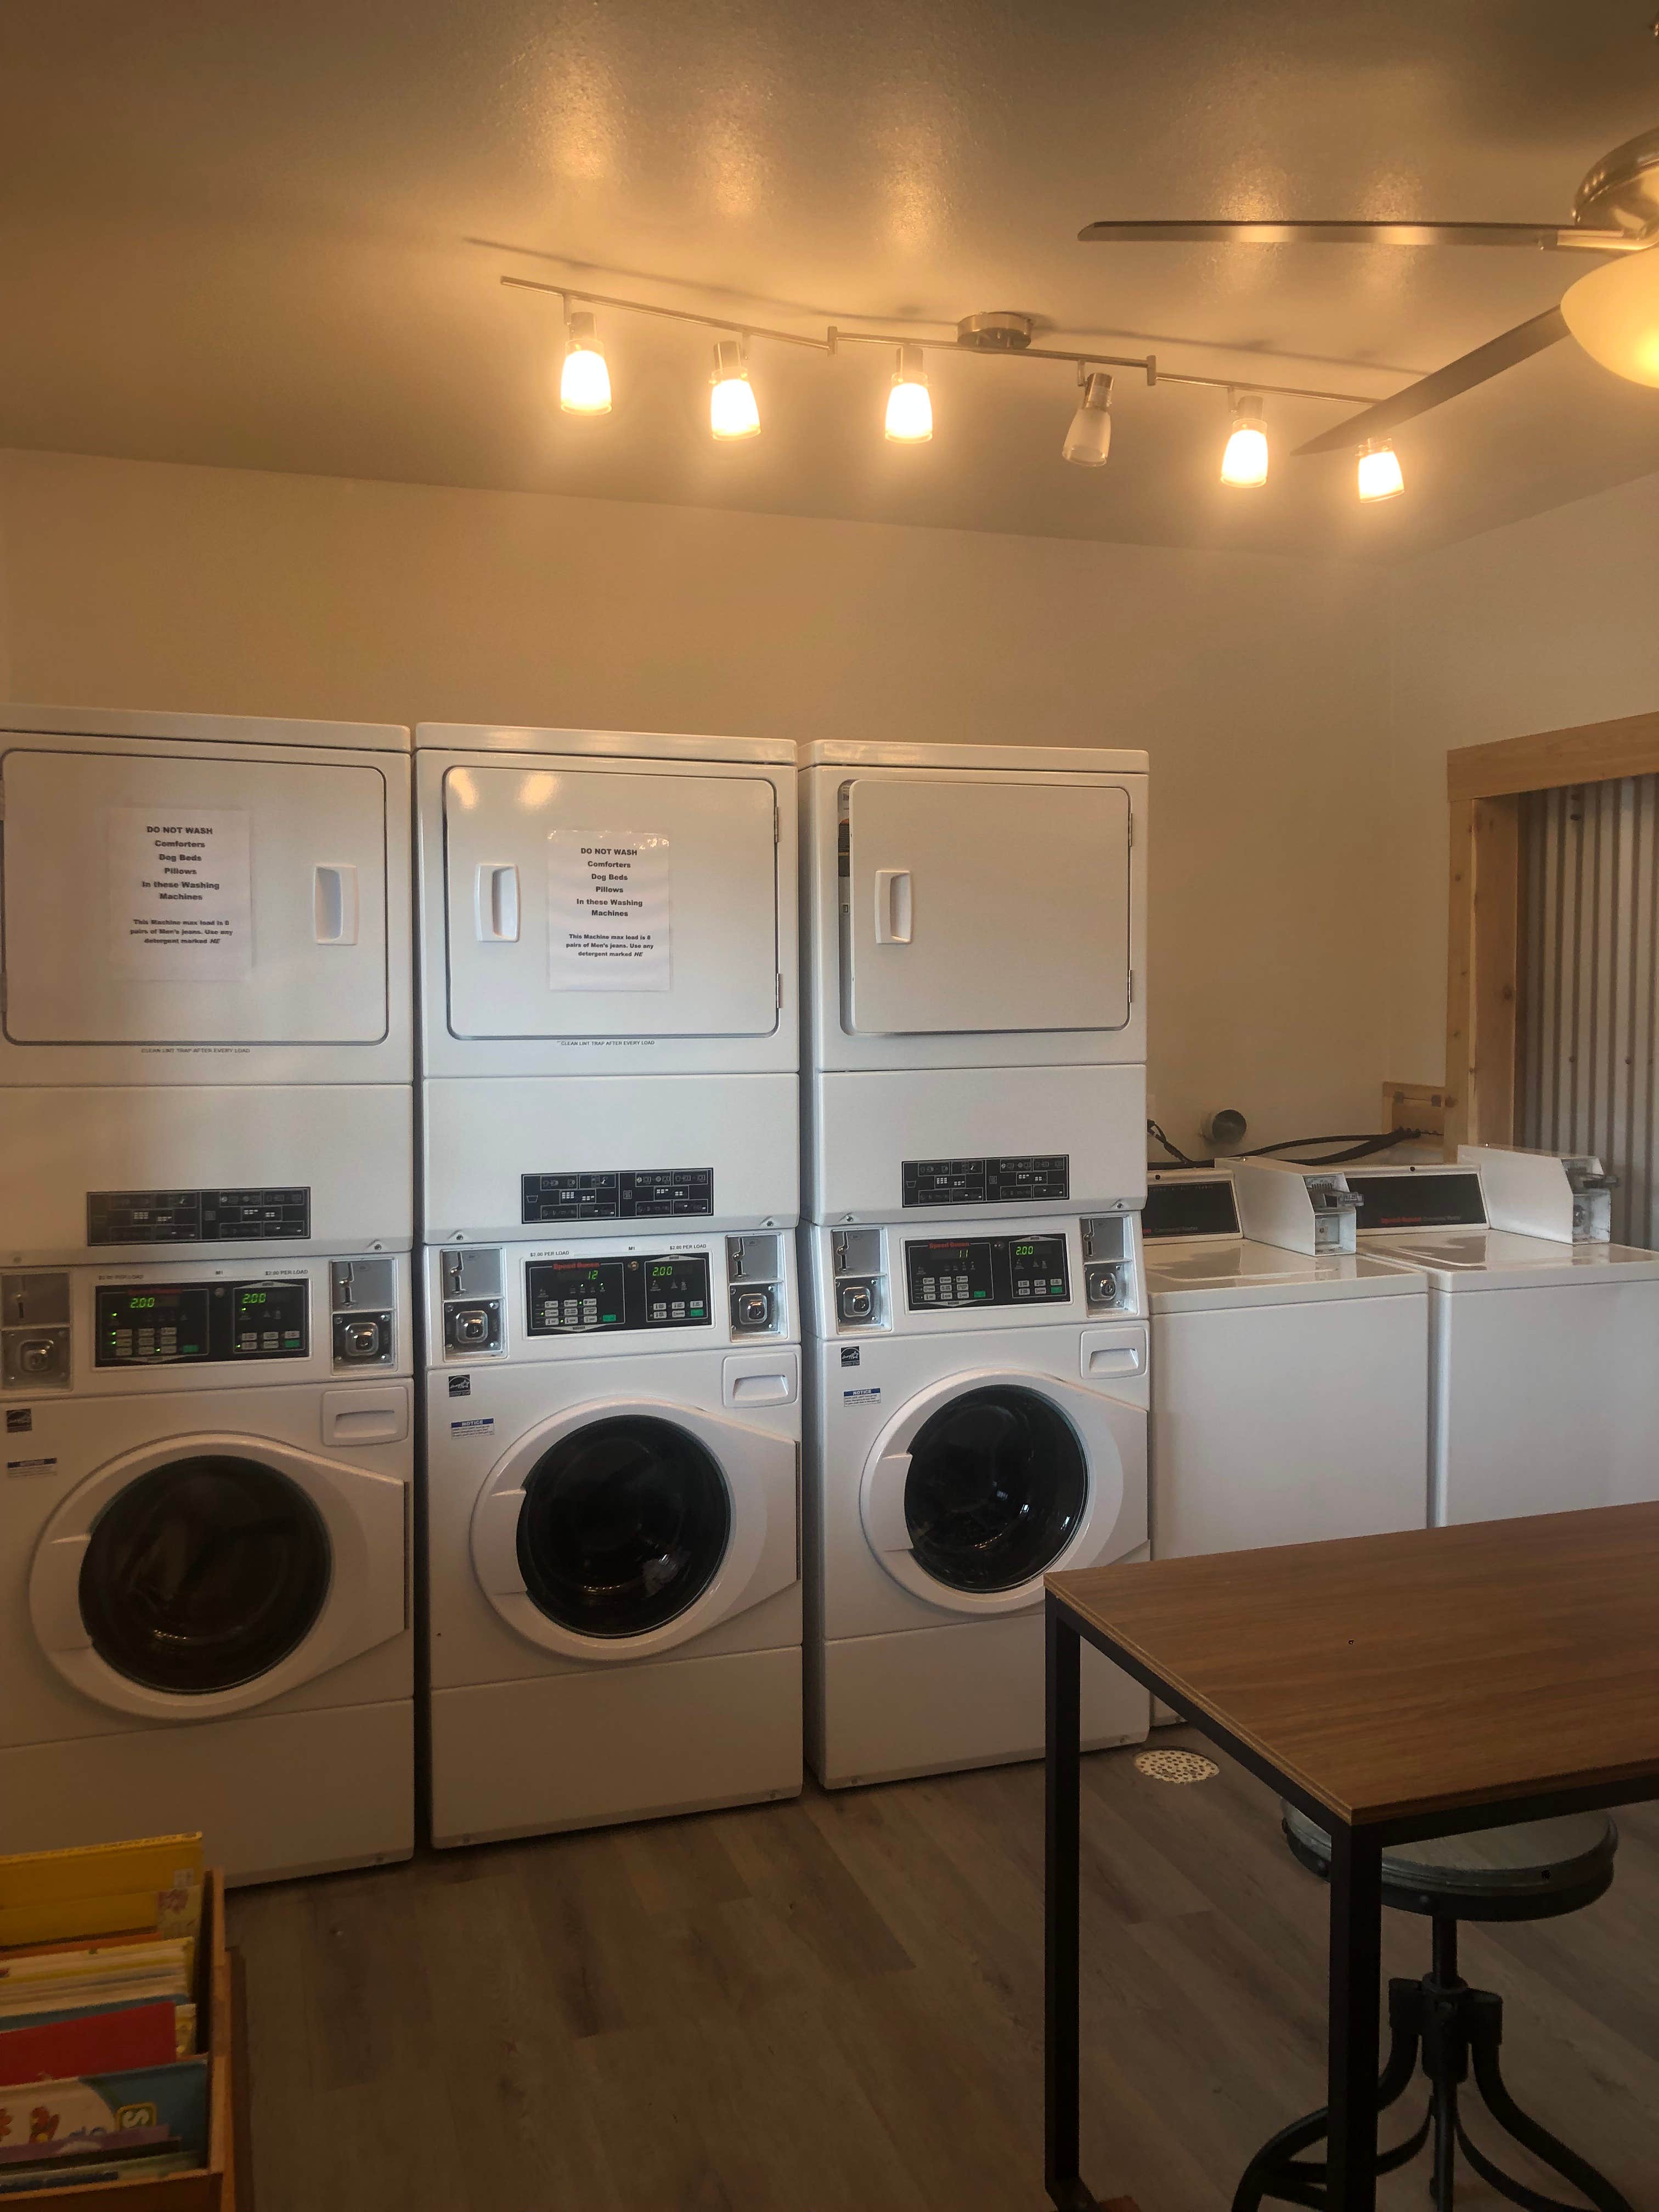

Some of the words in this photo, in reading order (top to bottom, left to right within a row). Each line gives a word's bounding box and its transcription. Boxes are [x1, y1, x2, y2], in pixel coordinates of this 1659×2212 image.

[159, 854, 176, 862] Dog
[181, 882, 219, 890] Washing
[610, 899, 643, 907] Washing
[1016, 1246, 1034, 1256] 2.00
[588, 1269, 599, 1280] 12
[652, 1266, 673, 1276] 2.00
[129, 1297, 155, 1308] 2.00
[242, 1293, 266, 1304] 2.00
